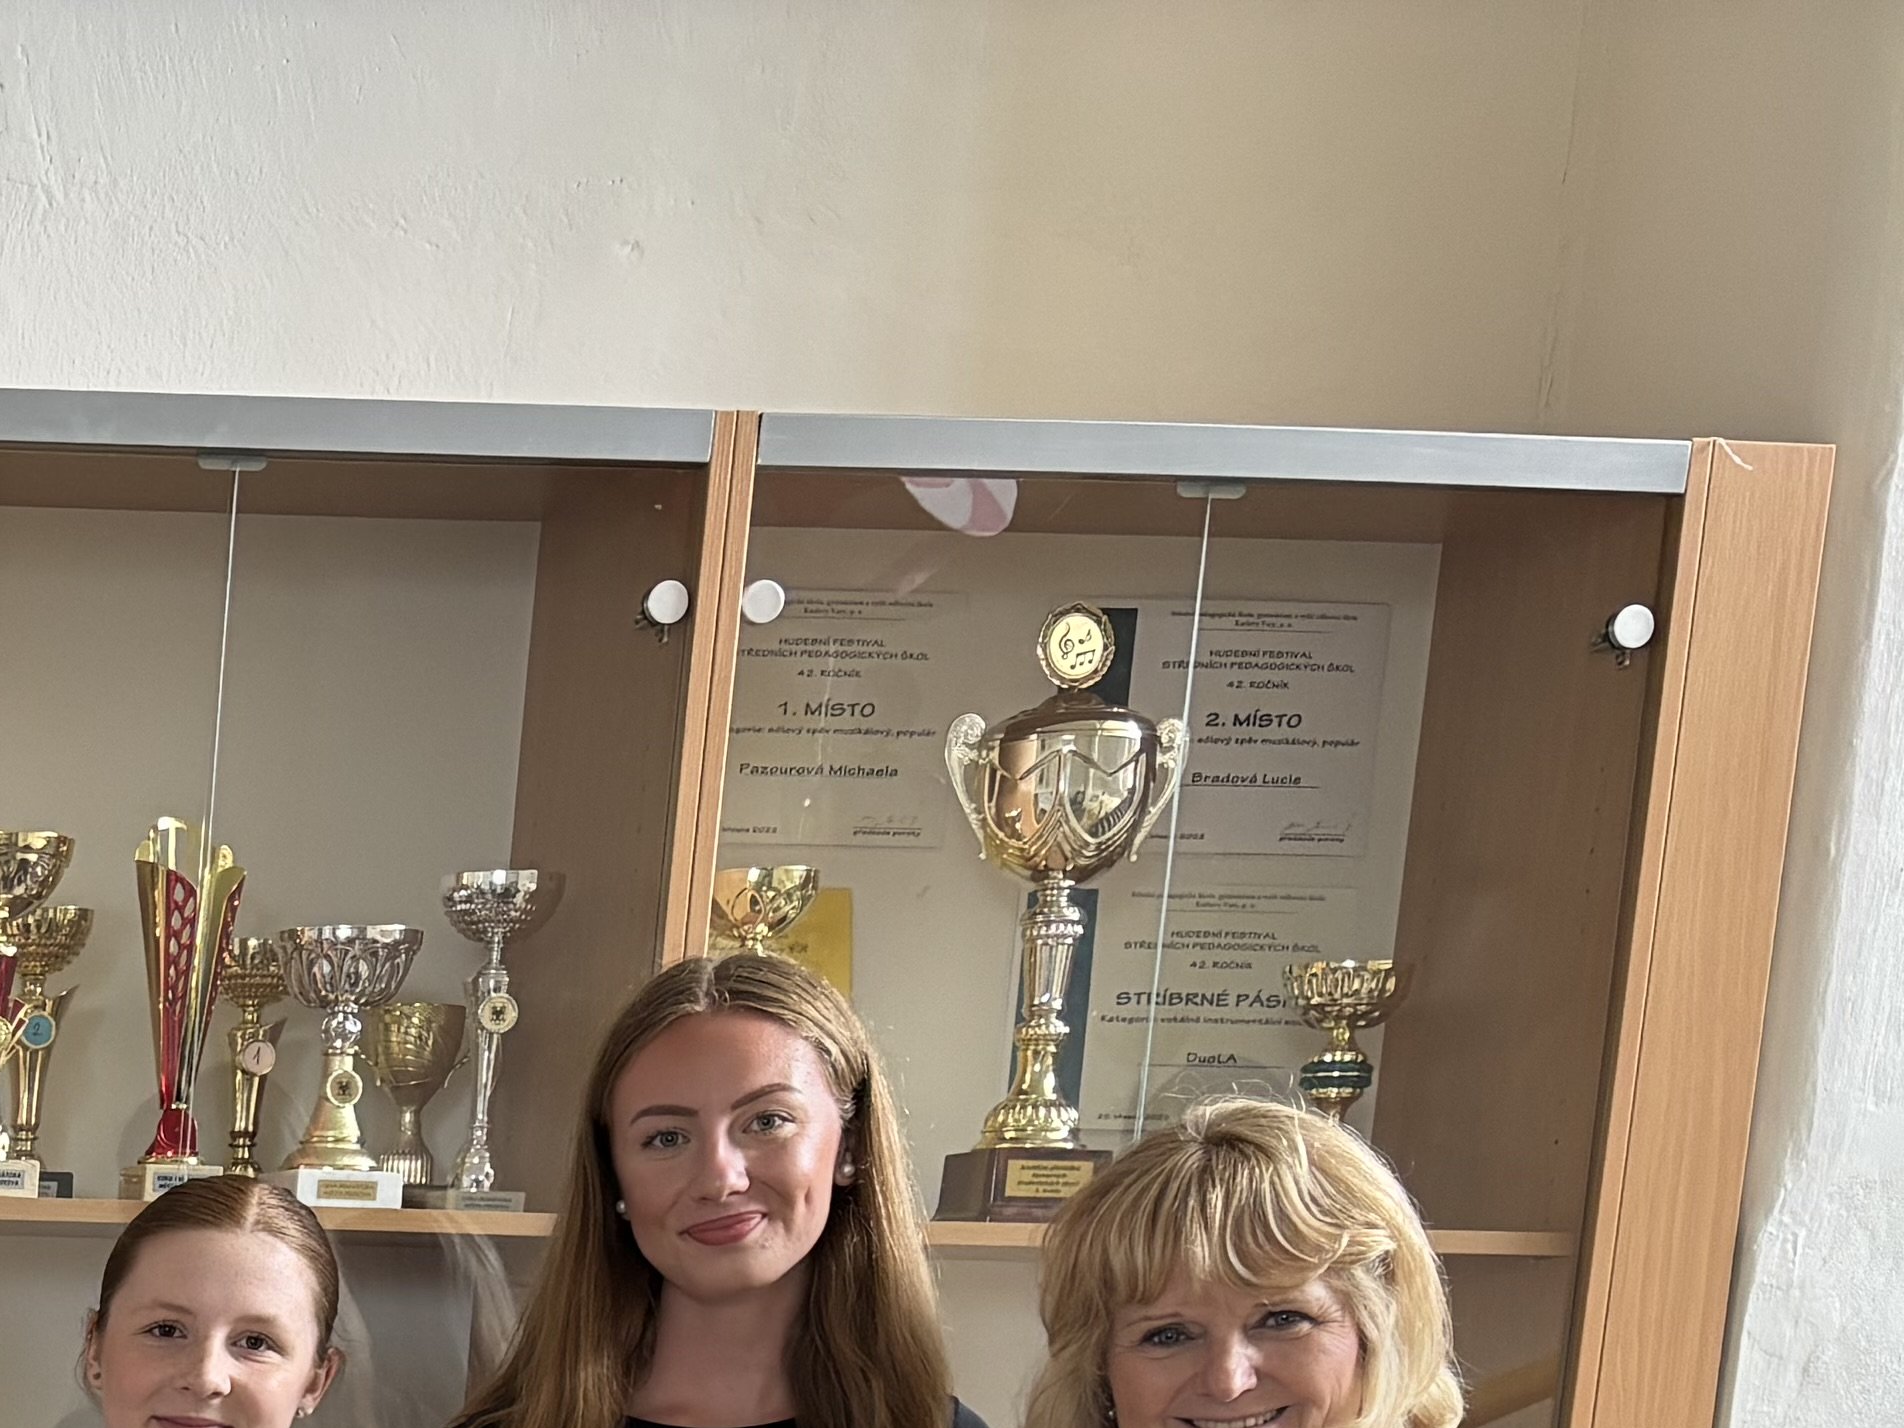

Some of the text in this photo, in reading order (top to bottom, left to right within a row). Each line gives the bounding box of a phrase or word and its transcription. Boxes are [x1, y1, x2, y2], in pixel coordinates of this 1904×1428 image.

[778, 698, 875, 717] 1. MÍSTO
[1205, 709, 1302, 728] 2. MÍSTO
[740, 763, 898, 777] Pazourová Michaela
[1191, 771, 1302, 785] Bradová Lucie
